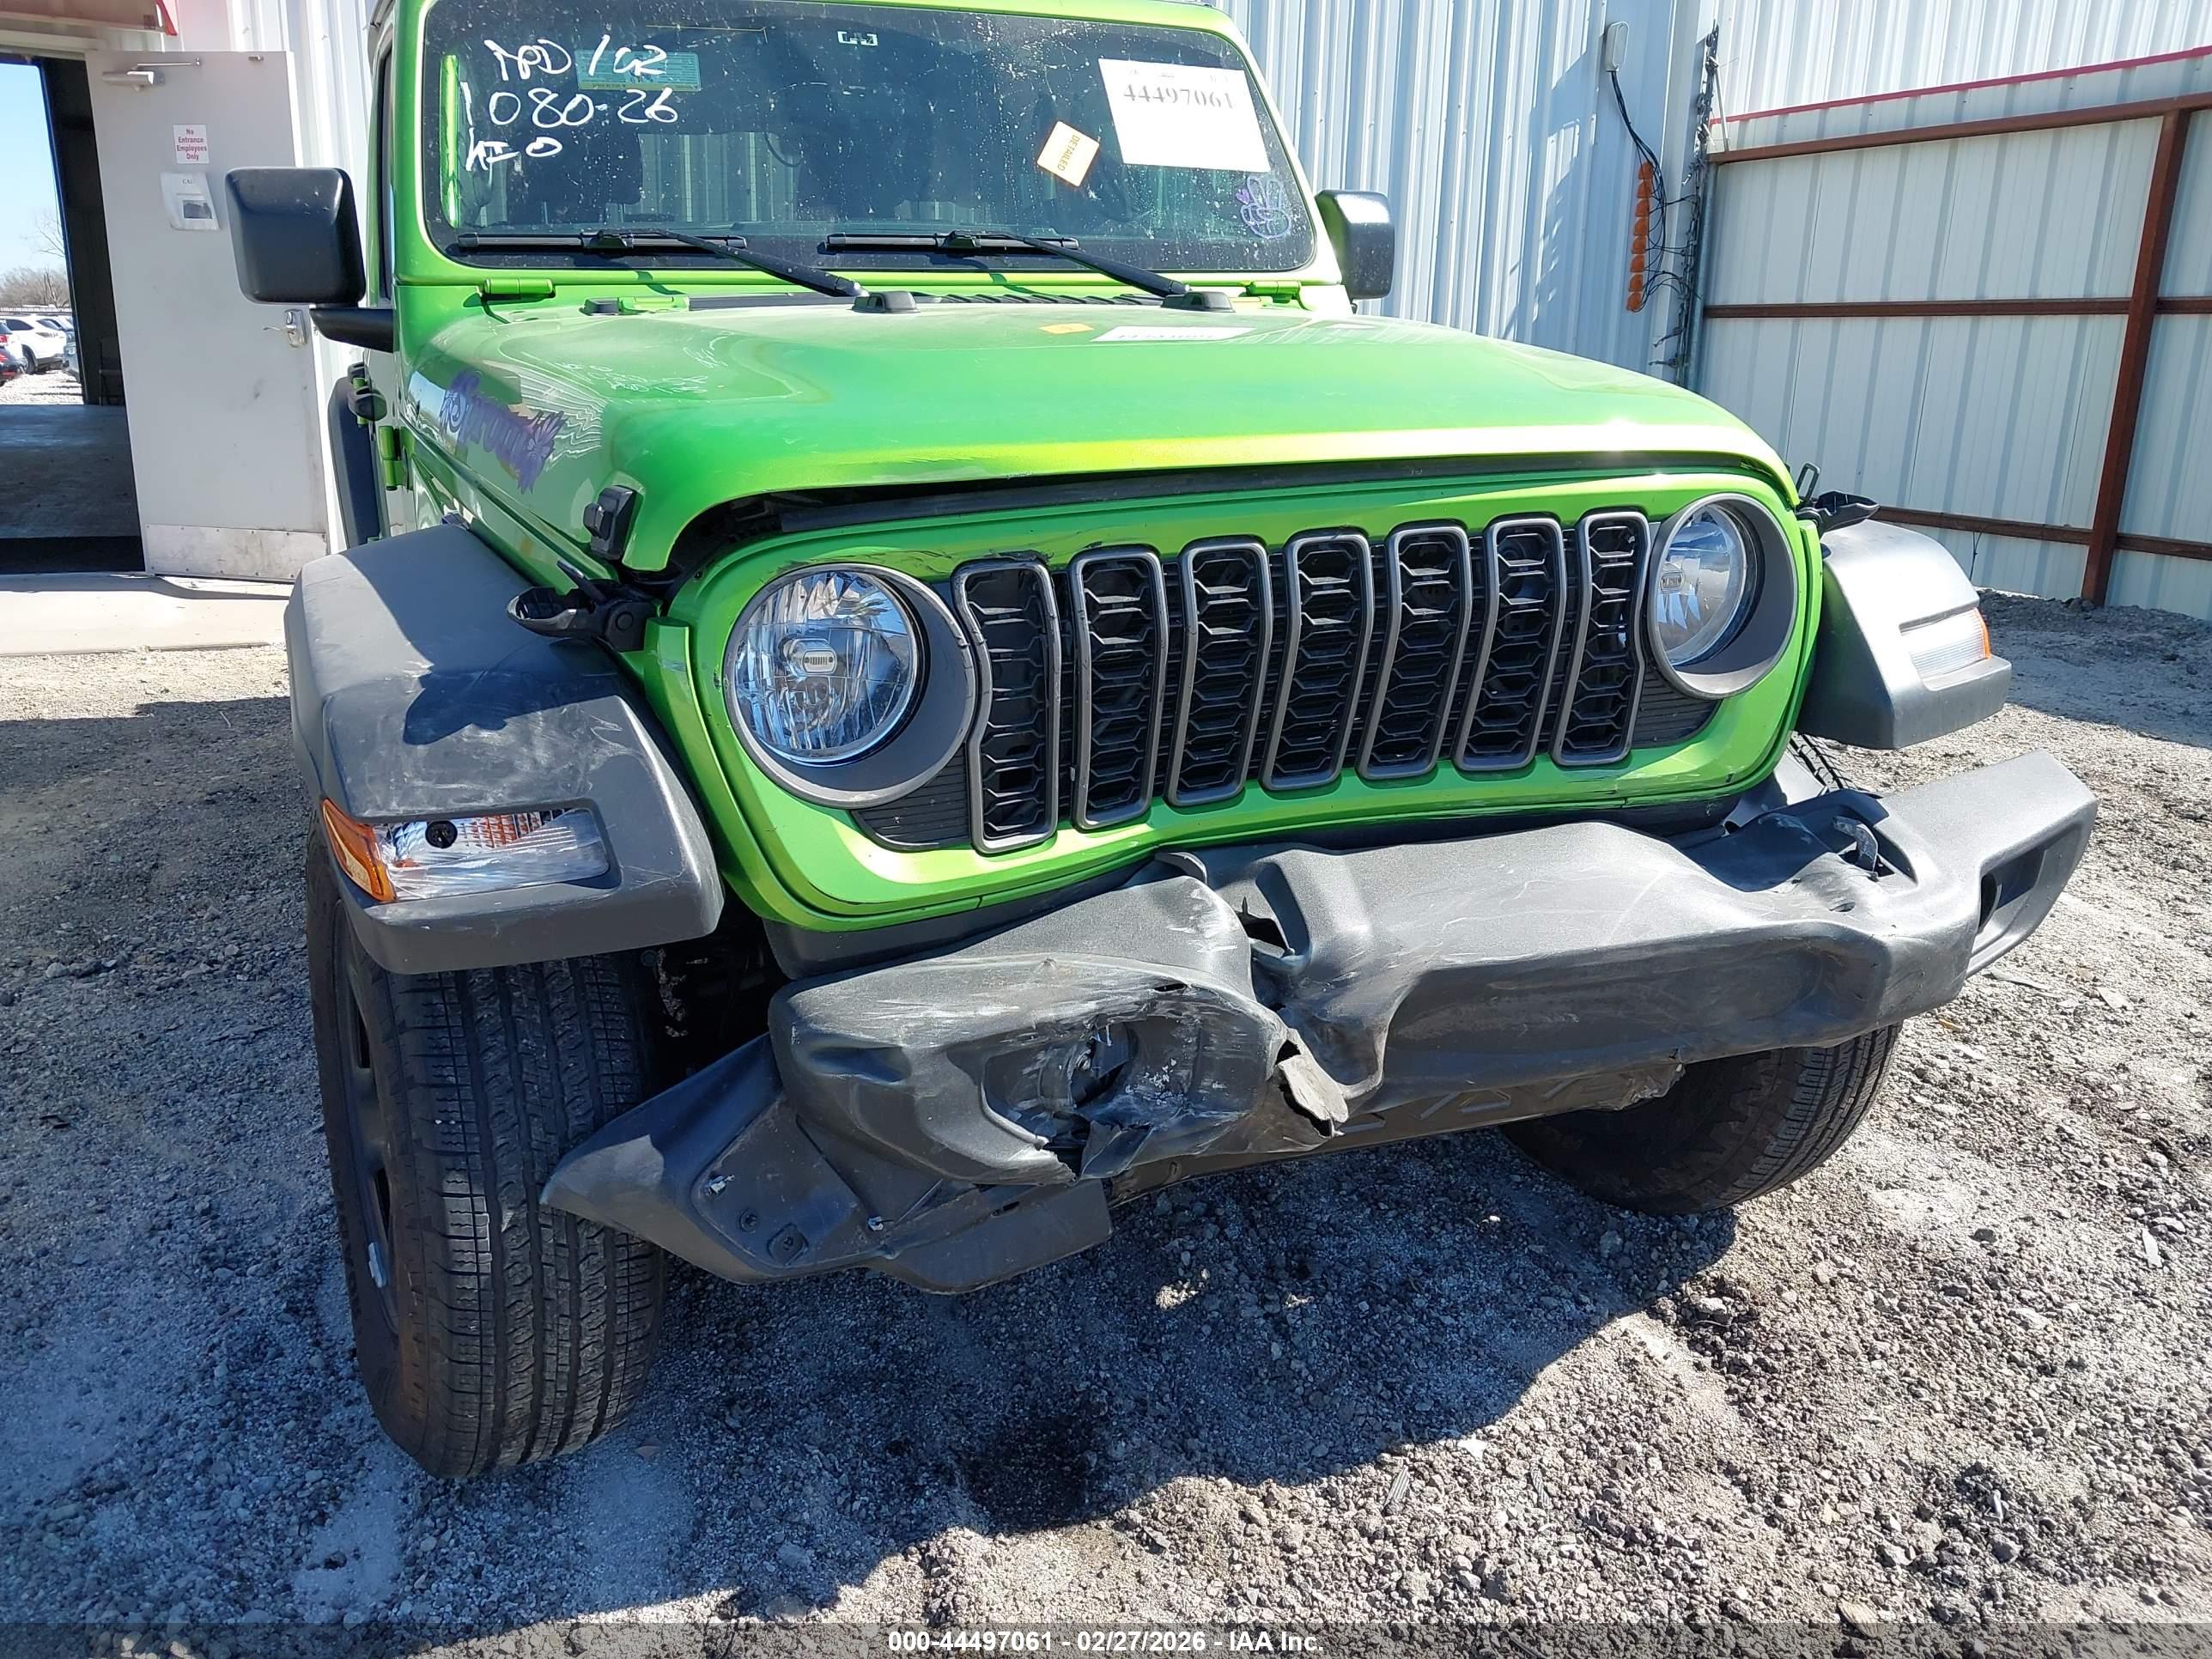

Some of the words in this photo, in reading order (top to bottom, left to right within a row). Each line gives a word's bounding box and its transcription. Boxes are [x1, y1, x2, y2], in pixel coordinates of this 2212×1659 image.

[1124, 83, 1234, 109] 44497061
[176, 144, 207, 153] Employees
[1057, 134, 1080, 171] DETAILED
